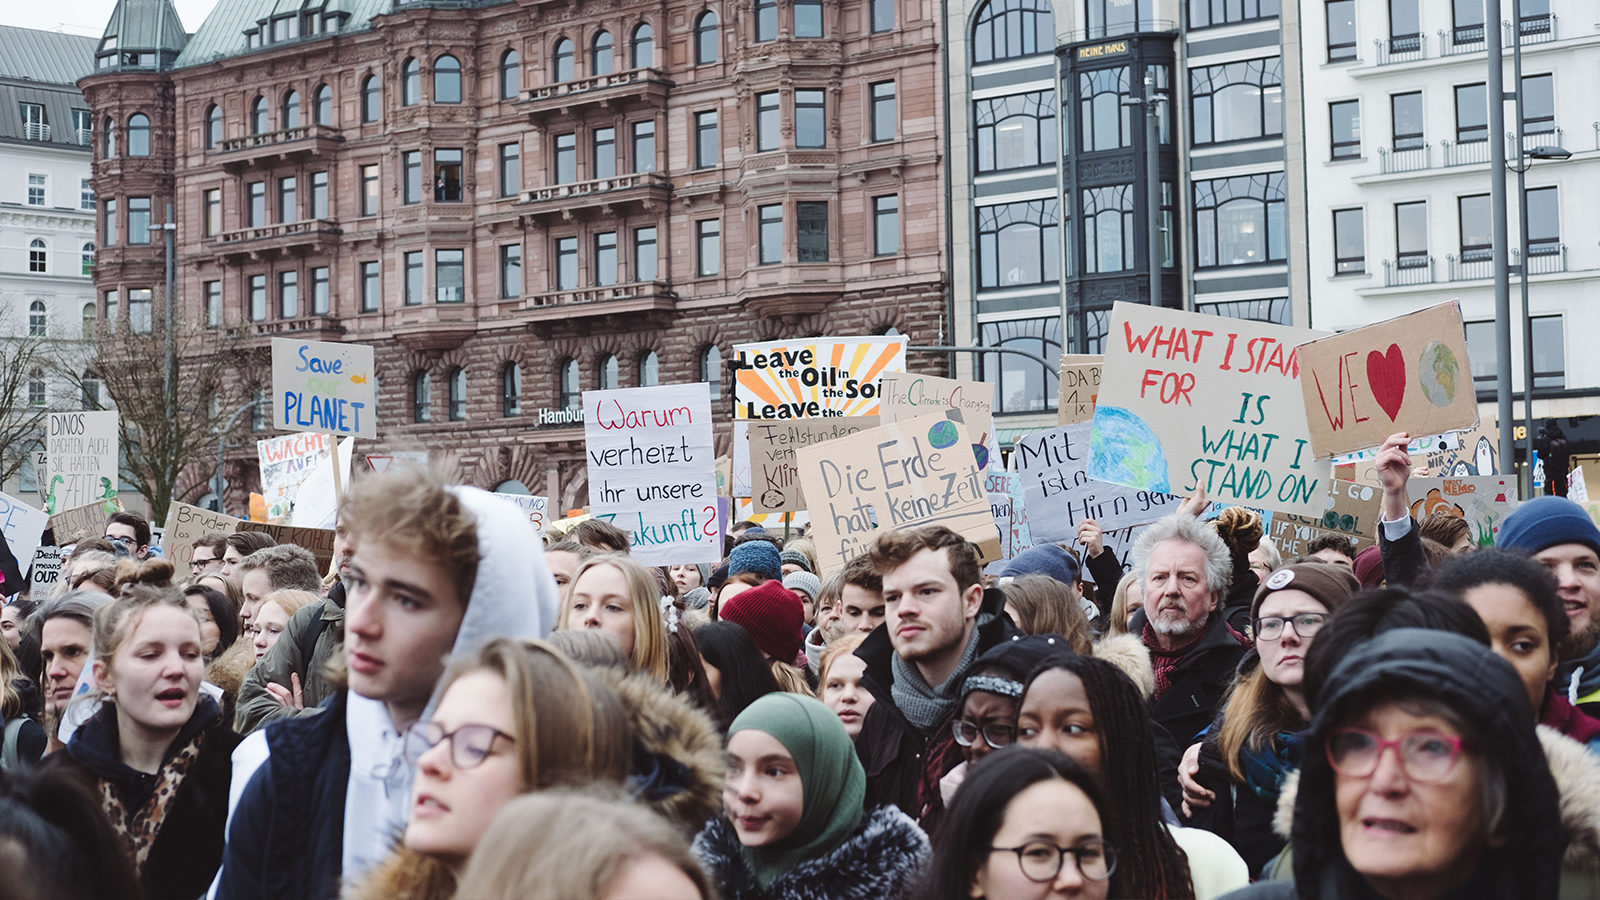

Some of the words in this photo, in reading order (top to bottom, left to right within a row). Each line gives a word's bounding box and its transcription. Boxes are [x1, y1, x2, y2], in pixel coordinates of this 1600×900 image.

[1105, 42, 1126, 54] HAUS
[1123, 321, 1214, 364] WHAT
[1219, 333, 1238, 370] I
[295, 344, 344, 374] Save
[740, 349, 813, 370] Leave
[307, 377, 342, 396] our
[779, 368, 799, 378] the
[801, 366, 836, 387] Oil
[838, 369, 849, 379] in
[1066, 369, 1089, 388] DA
[1089, 367, 1102, 386] B
[823, 388, 843, 398] the
[881, 378, 907, 405] The
[908, 379, 941, 406] Climate
[942, 397, 949, 406] is
[949, 385, 990, 413] Changing
[1140, 369, 1196, 407] FOR
[1311, 350, 1371, 432] WE
[284, 391, 365, 433] PLANET
[596, 399, 693, 430] Warum
[747, 401, 819, 420] Leave
[822, 408, 843, 417] the
[1233, 391, 1271, 426] IS
[51, 413, 85, 436] DINOS
[51, 438, 83, 455] DACHTEN
[87, 437, 109, 455] AUCH
[265, 433, 325, 463] WACHT
[590, 435, 693, 467] verheizt
[1019, 432, 1081, 469] Mit
[1201, 425, 1279, 465] WHAT
[1289, 438, 1308, 469] I
[51, 455, 64, 472] SIE
[286, 454, 318, 474] AUF!
[819, 459, 876, 498] Die
[877, 436, 947, 490] Erde
[599, 480, 625, 502] ihr
[636, 482, 703, 501] unsere
[984, 475, 1012, 494] SERE
[1038, 469, 1072, 498] ist
[1184, 459, 1272, 500] STAND
[1278, 468, 1319, 505] ON
[1347, 484, 1373, 502] GO
[1443, 484, 1476, 494] NEMO
[529, 498, 545, 510] NO
[829, 497, 872, 535] hat
[885, 491, 942, 525] keine
[939, 465, 984, 508] Zeit
[1067, 495, 1128, 527] Hirn
[177, 505, 231, 532] Bruder
[1275, 521, 1289, 535] IF
[173, 524, 190, 538] los
[1270, 536, 1300, 555] THE
[34, 571, 58, 583] OUR
